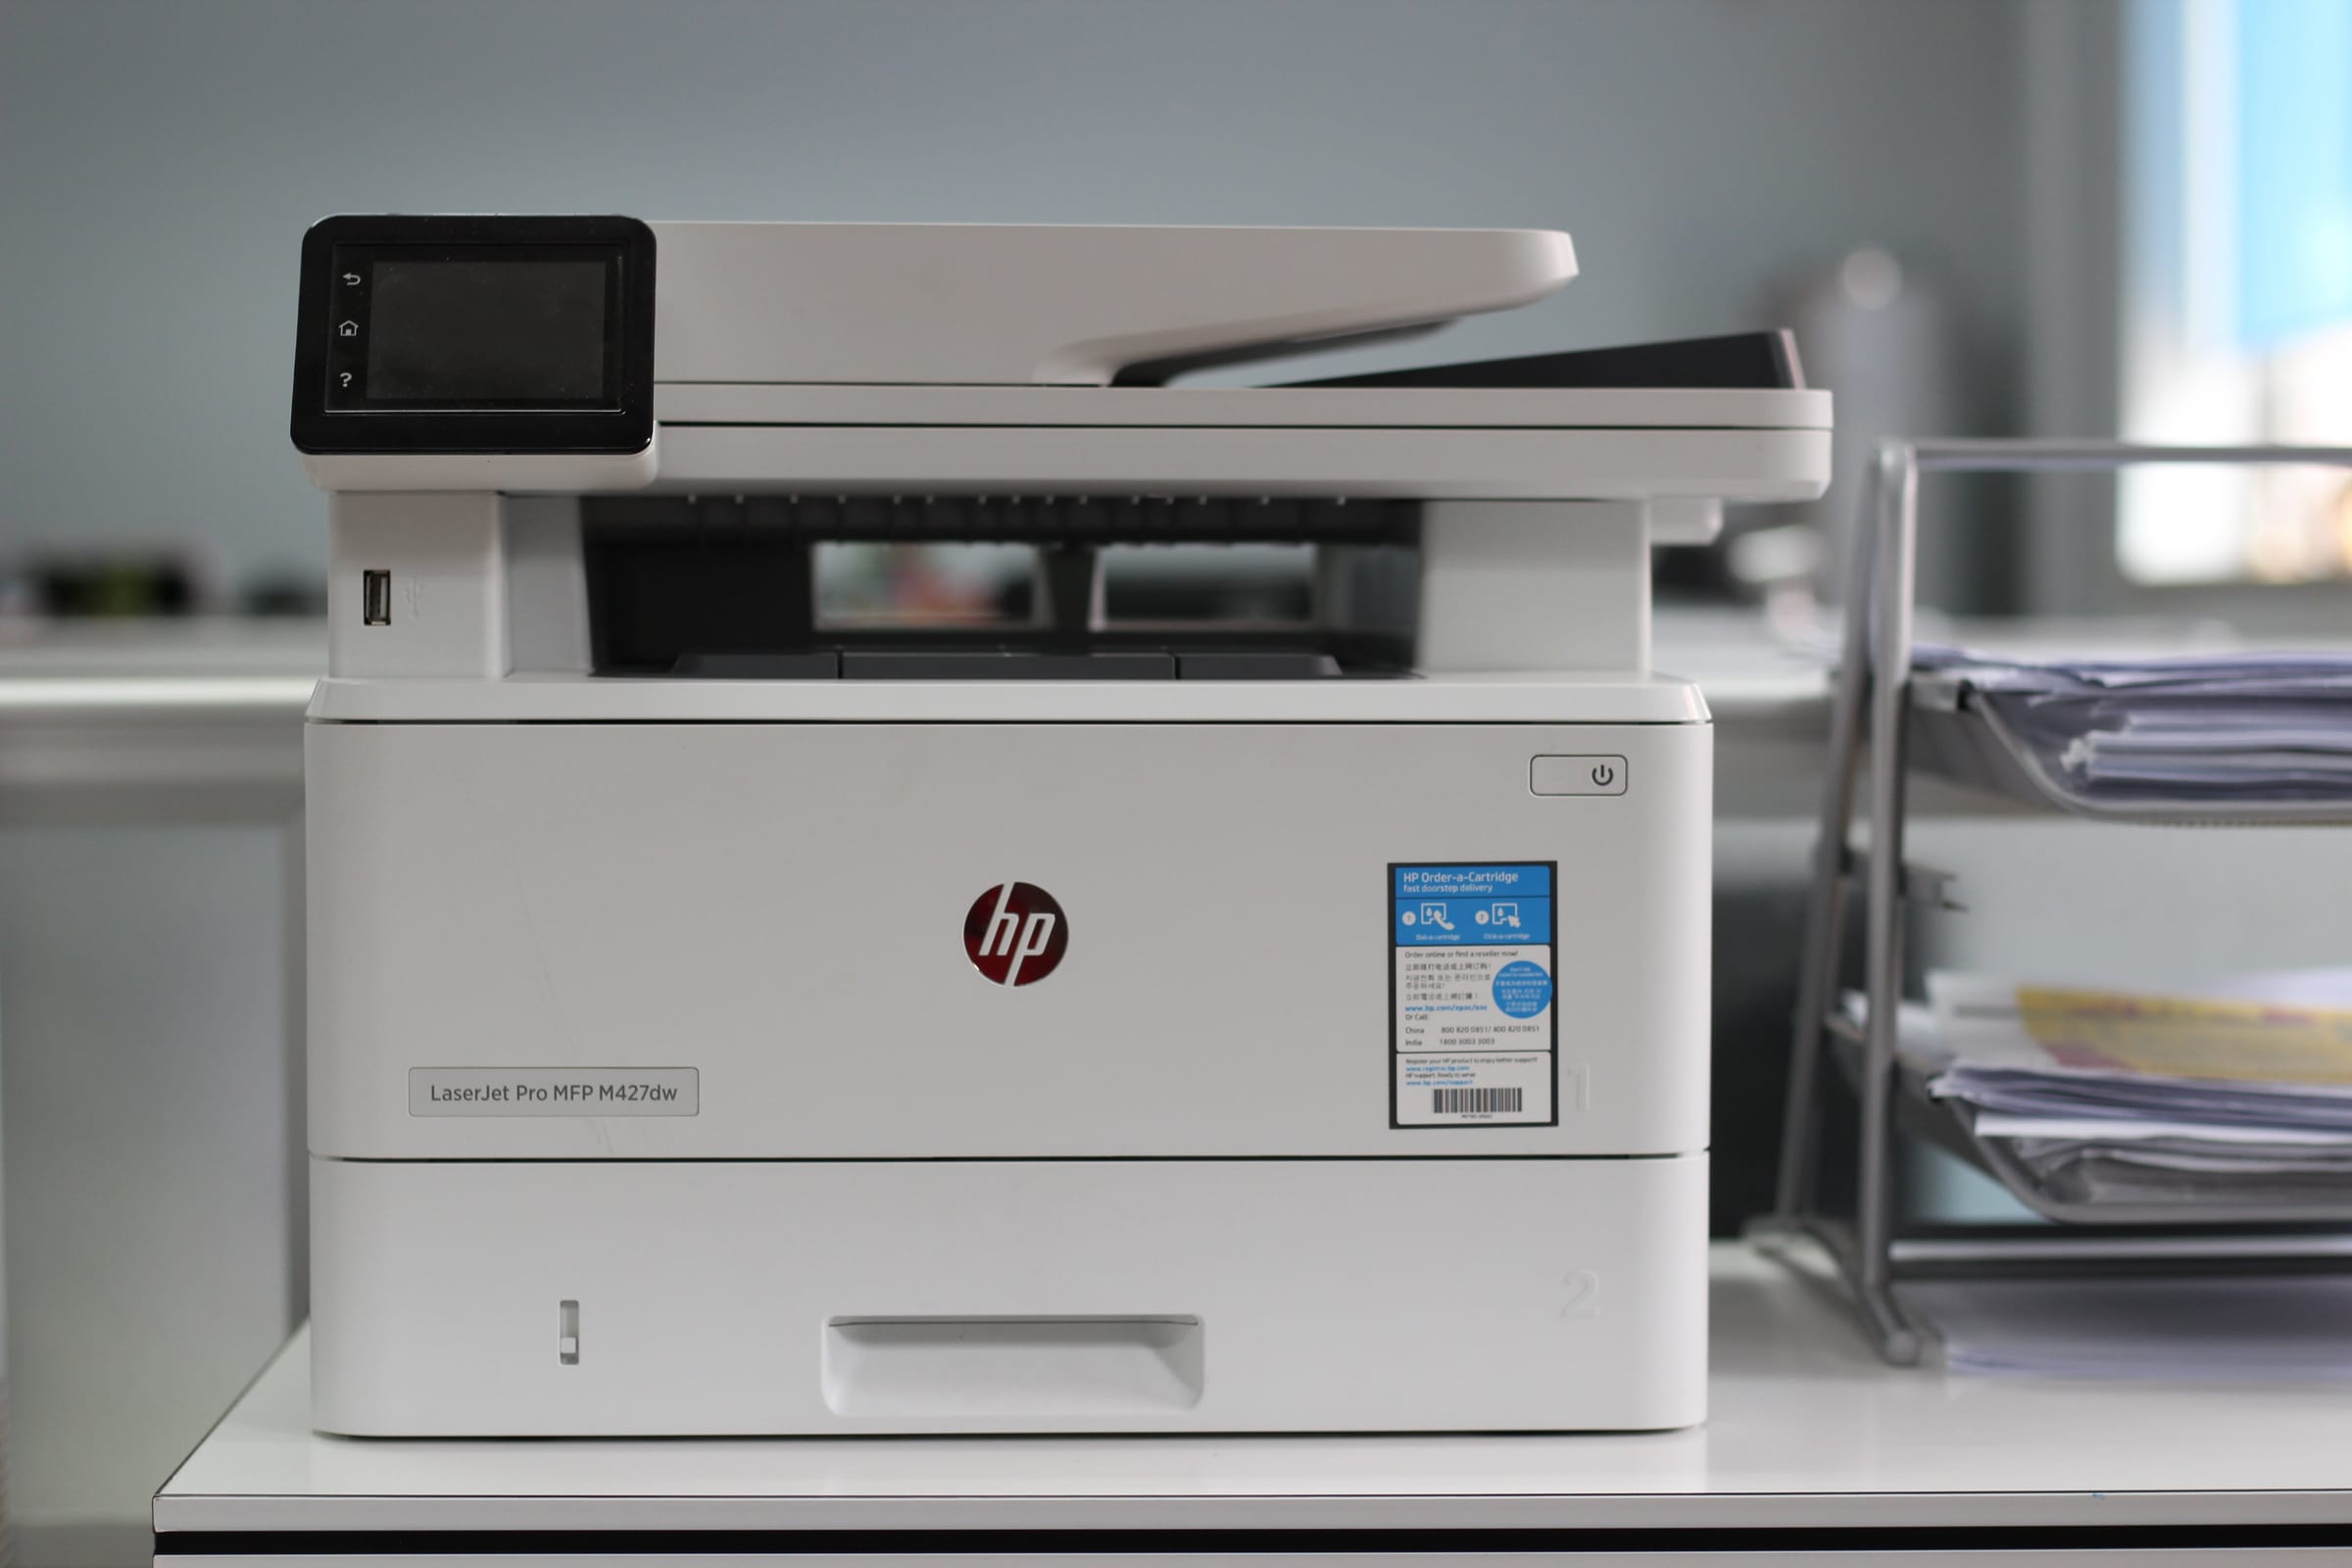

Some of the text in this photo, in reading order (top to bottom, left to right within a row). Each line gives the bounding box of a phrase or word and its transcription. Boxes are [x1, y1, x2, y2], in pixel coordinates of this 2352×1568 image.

[1403, 871, 1519, 884] HP Order-a-Cartridge
[1403, 883, 1494, 894] fast doorstep delivery
[978, 882, 1056, 987] hp
[430, 1083, 678, 1102] LaserJet Pro MFP M427dw
[1559, 1269, 1600, 1319] 2
